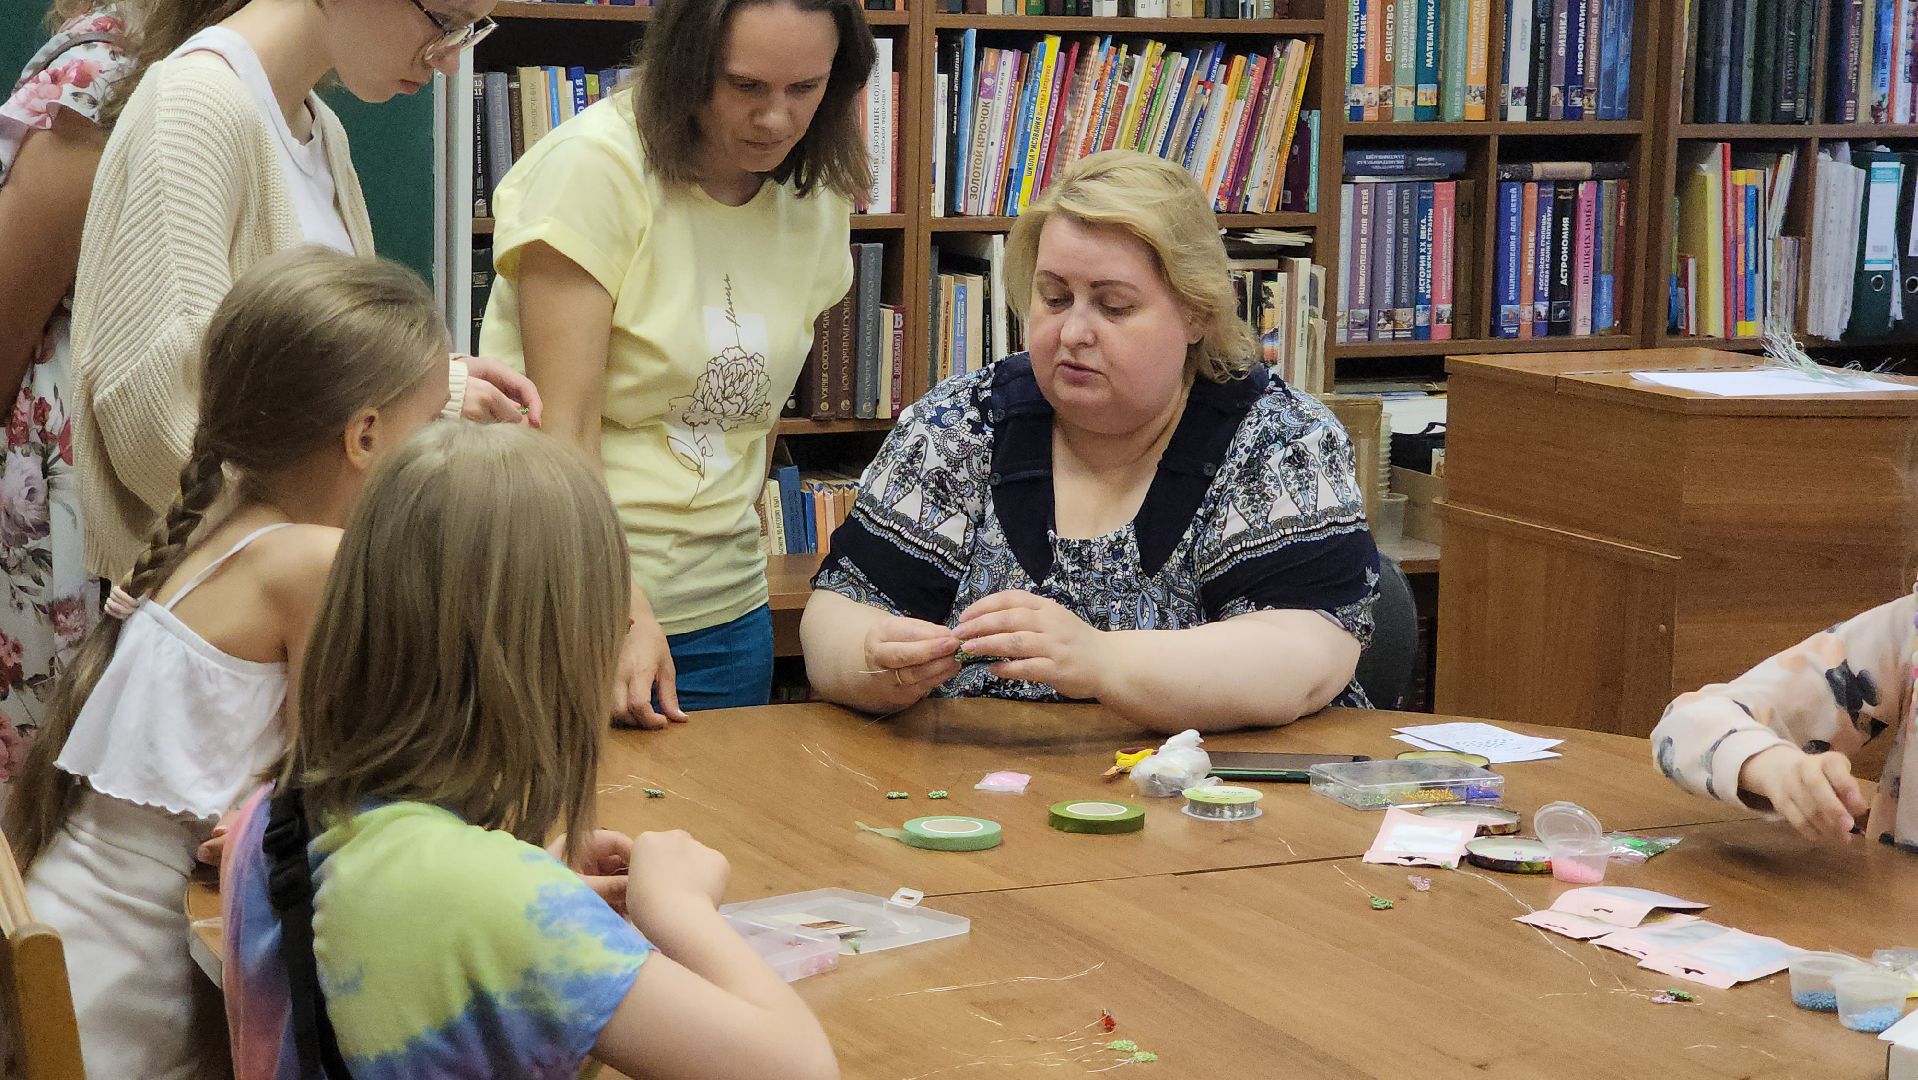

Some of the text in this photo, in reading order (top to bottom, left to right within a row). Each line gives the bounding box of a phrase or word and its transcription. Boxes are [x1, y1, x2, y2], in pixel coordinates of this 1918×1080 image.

[1385, 4, 1393, 61] ОБЩЕСТВО
[1426, 0, 1434, 67] МАТЕМАТИКА
[1519, 18, 1528, 51] СПОРТ
[1558, 11, 1568, 56] ФИЗИКА
[969, 99, 991, 200] ЗОЛОТОЙ КРЮЧОК
[1029, 117, 1042, 152] РИСОВАНИЯ
[1026, 155, 1036, 176] ШКОЛА
[1527, 231, 1535, 275] ЧЕЛОВЕК
[1560, 217, 1570, 285] АСТРОНОМИЯ
[1582, 235, 1591, 285] ВЕЛИКИХ
[841, 297, 851, 390] ИНОСТРАННЫХ СЛОВ
[821, 372, 829, 399] ЯЗЫКА
